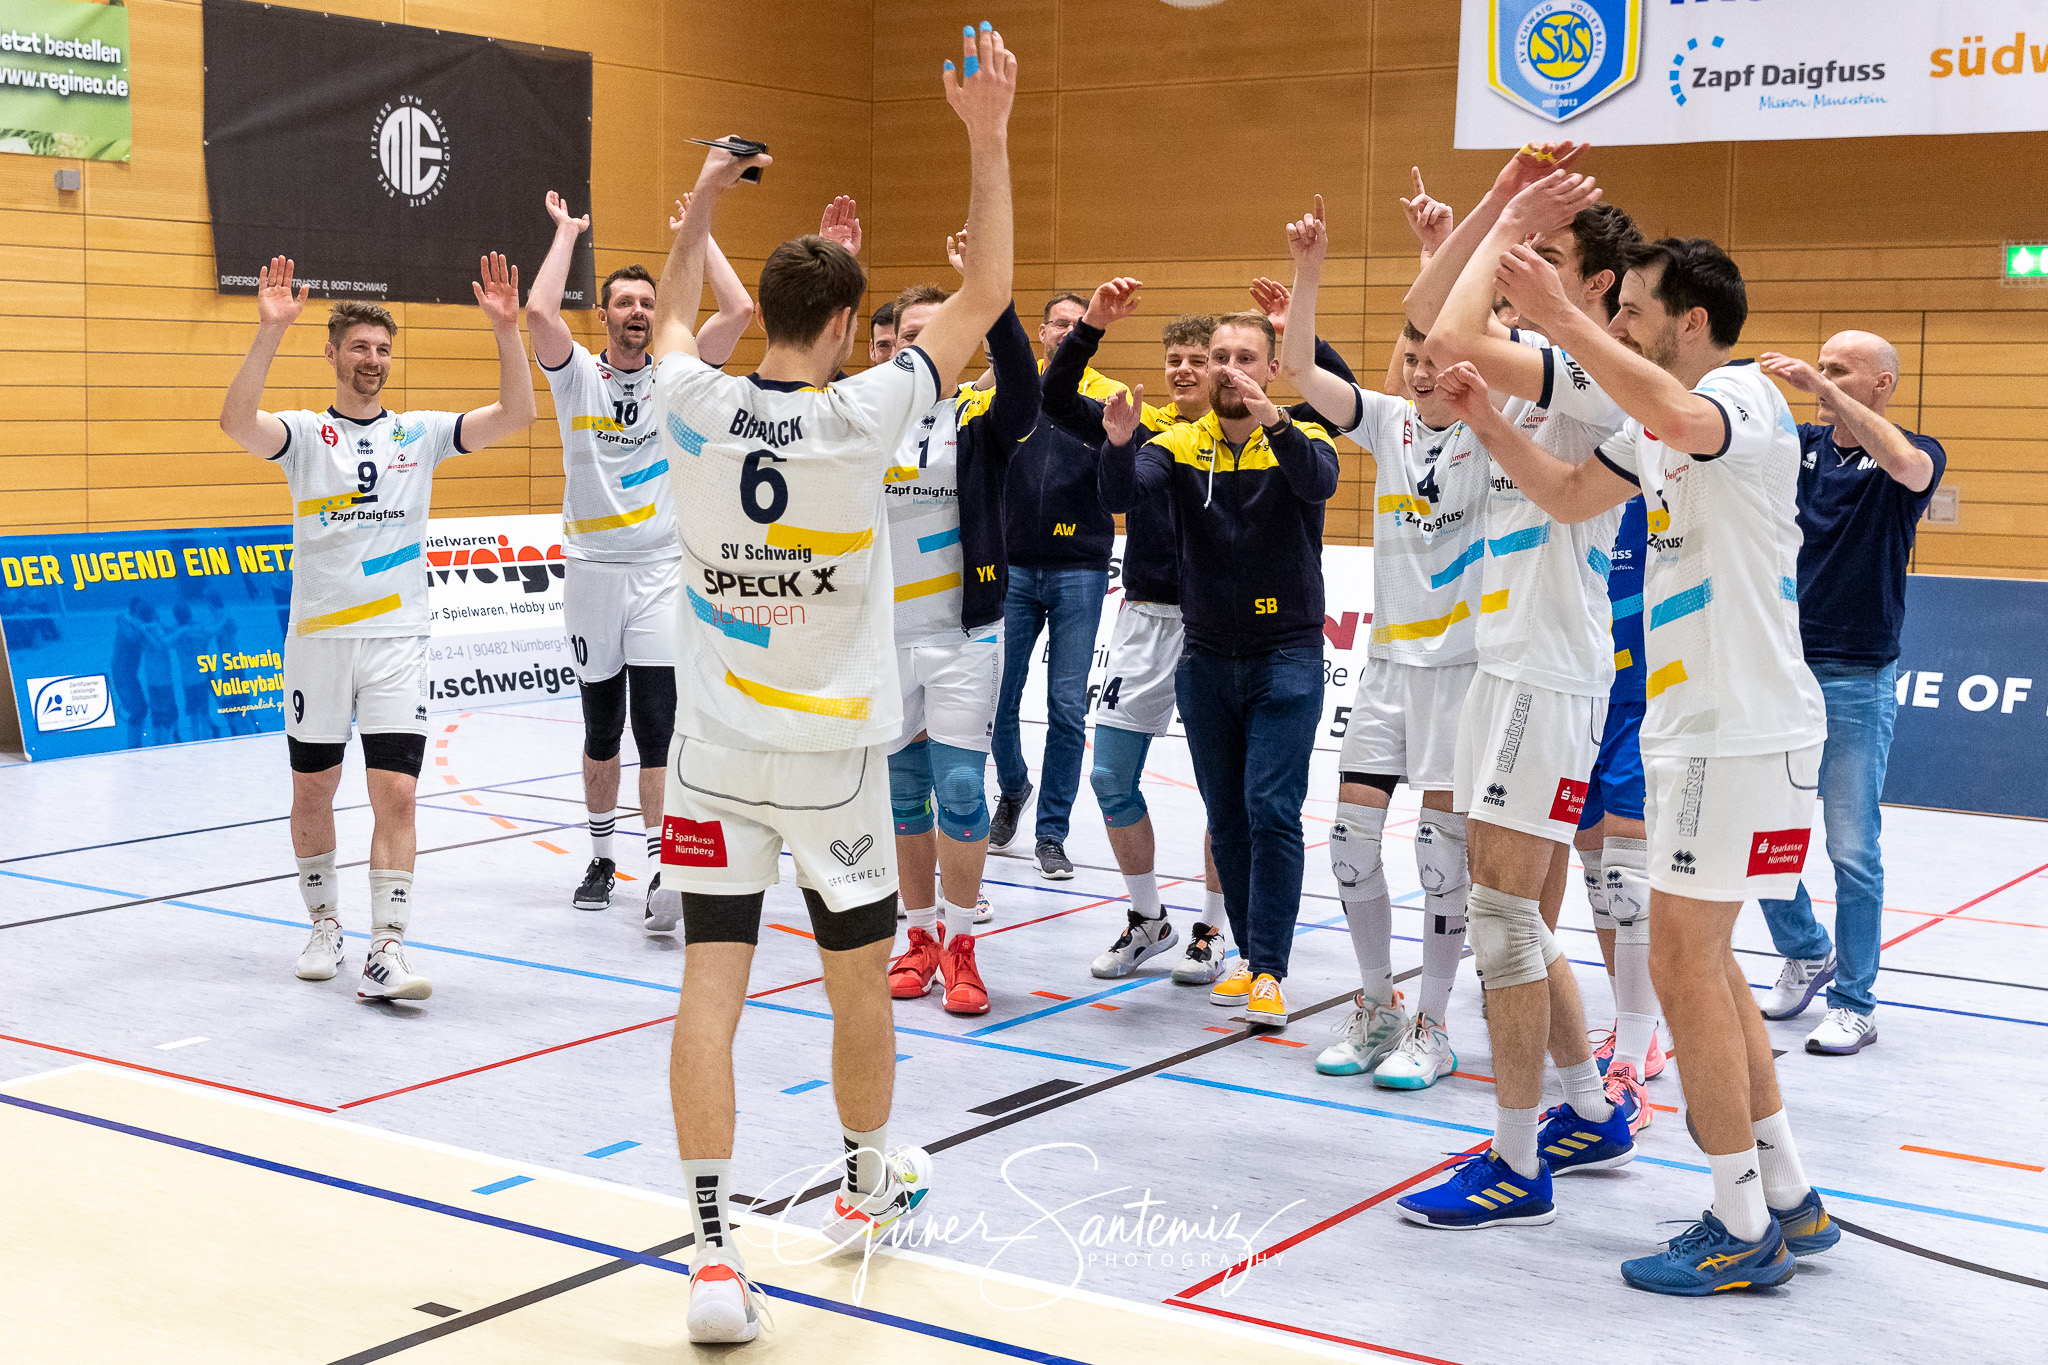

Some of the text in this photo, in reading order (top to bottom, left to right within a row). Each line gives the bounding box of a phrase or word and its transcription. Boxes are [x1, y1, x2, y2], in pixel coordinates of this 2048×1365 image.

[0, 30, 121, 63] etzt bestellen
[1692, 60, 1886, 92] Zapf Daigfuss
[400, 95, 422, 105] GYM
[371, 102, 391, 159] FITNESS
[352, 282, 388, 293] SCHWAIG
[613, 401, 638, 426] 10
[596, 430, 620, 443] Zapf
[357, 461, 378, 493] 9
[1417, 465, 1440, 504] 4
[740, 449, 788, 524] 6
[885, 484, 911, 496] Zapf
[330, 509, 405, 522] Zapf Daigfuss
[1053, 523, 1076, 536] AW
[426, 534, 496, 549] ielwaren
[721, 543, 811, 563] SV Schwaig
[1, 555, 64, 588] DER
[71, 549, 177, 591] JUGEND
[183, 547, 231, 577] EIN
[976, 565, 996, 582] YK
[704, 568, 803, 598] SPECK
[442, 605, 508, 621] Spielwaren,
[510, 602, 545, 615] Hobby
[1254, 598, 1278, 615] SB
[473, 643, 508, 657] 90482
[571, 635, 588, 667] 10
[197, 649, 282, 673] SV Schwaig
[211, 673, 284, 698] Volleyball
[1957, 674, 2033, 714] OF
[66, 704, 88, 716] BVV
[293, 689, 305, 724] 9
[1483, 795, 1506, 808] errea
[675, 833, 715, 846] Sparkasse
[1770, 843, 1803, 854] Sparkasse
[675, 845, 715, 858] Nürnberg
[1767, 854, 1799, 864] Nürnberg
[828, 867, 886, 888] OFFICEWELT
[1671, 864, 1696, 875] errea
